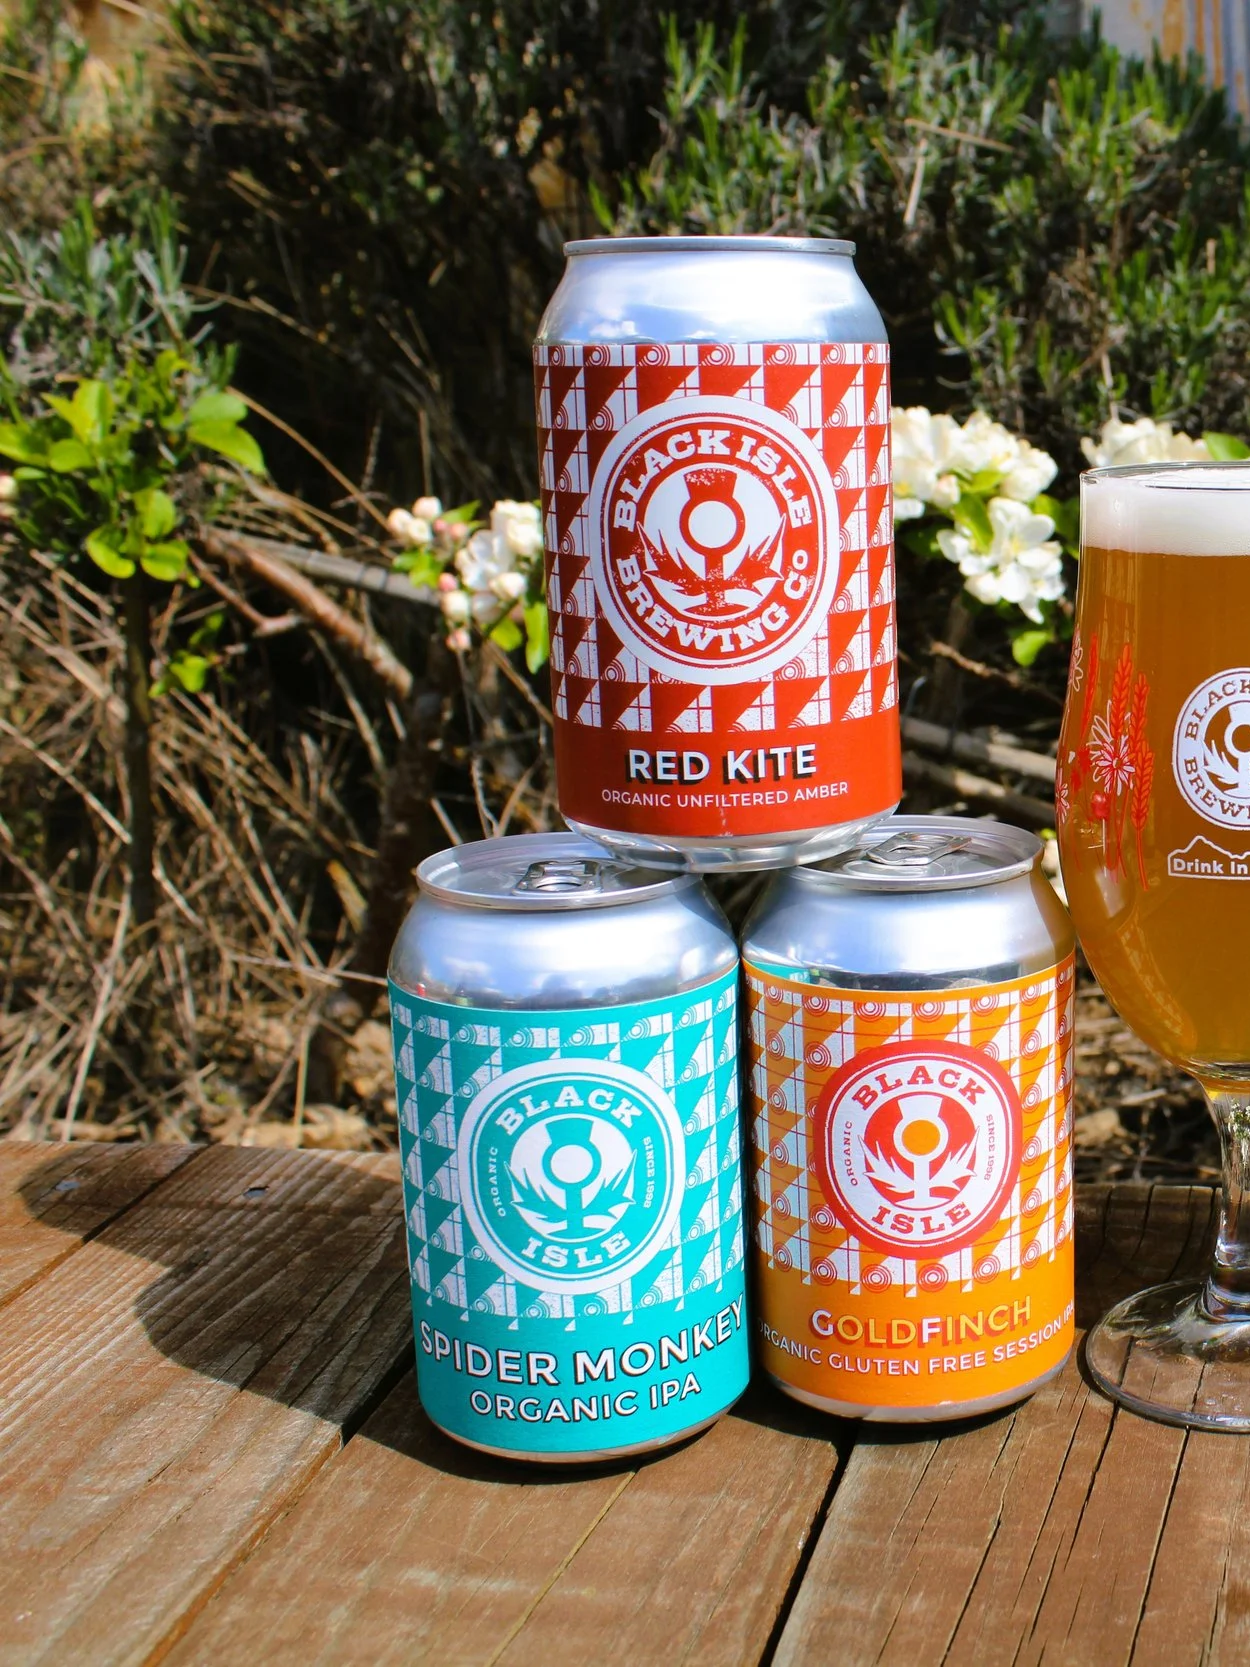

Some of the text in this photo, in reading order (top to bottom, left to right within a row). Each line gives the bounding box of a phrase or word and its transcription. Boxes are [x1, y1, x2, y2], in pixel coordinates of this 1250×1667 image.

[613, 429, 812, 533] BLACK ISLE
[616, 557, 791, 653] BREWING
[625, 743, 818, 785] RED KITE
[601, 781, 849, 808] ORGANIC UNFILTERED AMBER
[1173, 858, 1224, 874] Drink
[1230, 858, 1248, 875] In
[495, 1085, 643, 1135] BLACK
[851, 1065, 986, 1112] BLACK
[643, 1136, 655, 1178] SINCE
[845, 1119, 858, 1187] ORGANIC
[986, 1114, 995, 1152] SINCE
[490, 1146, 507, 1218] ORGANIC
[872, 1200, 972, 1236] ISLE
[521, 1230, 632, 1270] ISLE
[419, 1292, 745, 1386] SPIDER MONKEY
[810, 1295, 1031, 1347] GOLDFINCH
[828, 1353, 920, 1376] GLUTEN
[928, 1350, 986, 1374] FREE
[993, 1315, 1061, 1362] SESSION
[470, 1372, 702, 1424] ORGANIC IPA
